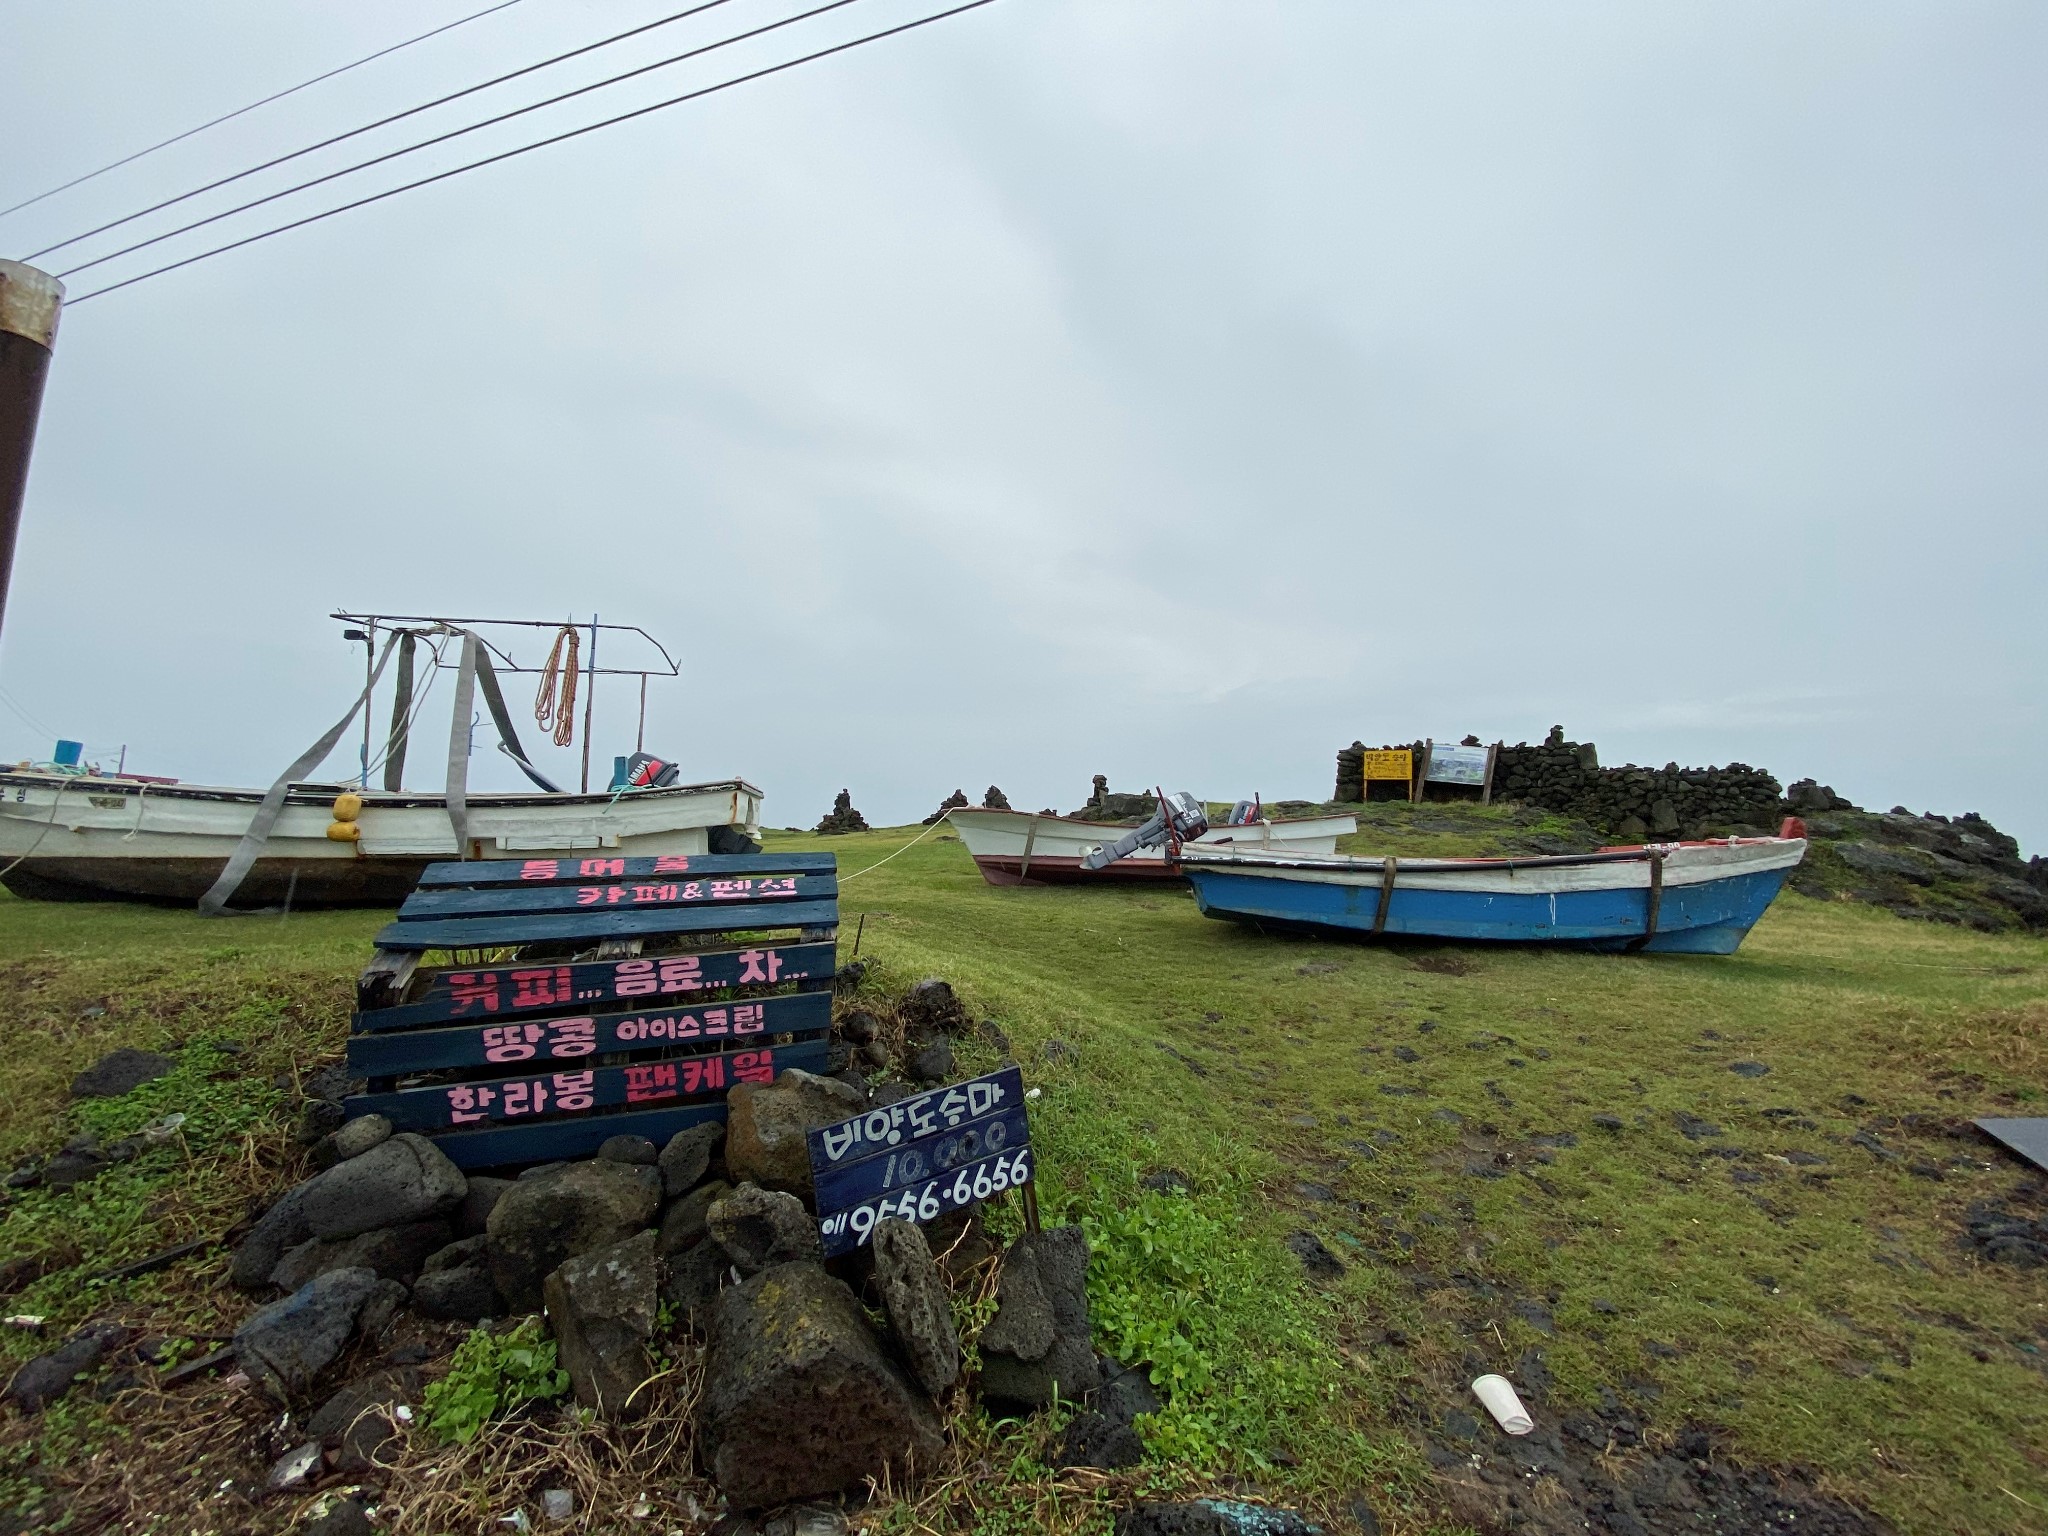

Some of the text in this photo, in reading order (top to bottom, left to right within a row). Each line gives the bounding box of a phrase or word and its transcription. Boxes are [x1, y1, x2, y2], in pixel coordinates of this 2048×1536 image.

[628, 759, 650, 784] AMAHA
[482, 1004, 764, 1063] 땅콩 아이스크림
[447, 1070, 594, 1124] 한라봉
[822, 1082, 1005, 1161] 비양도승마
